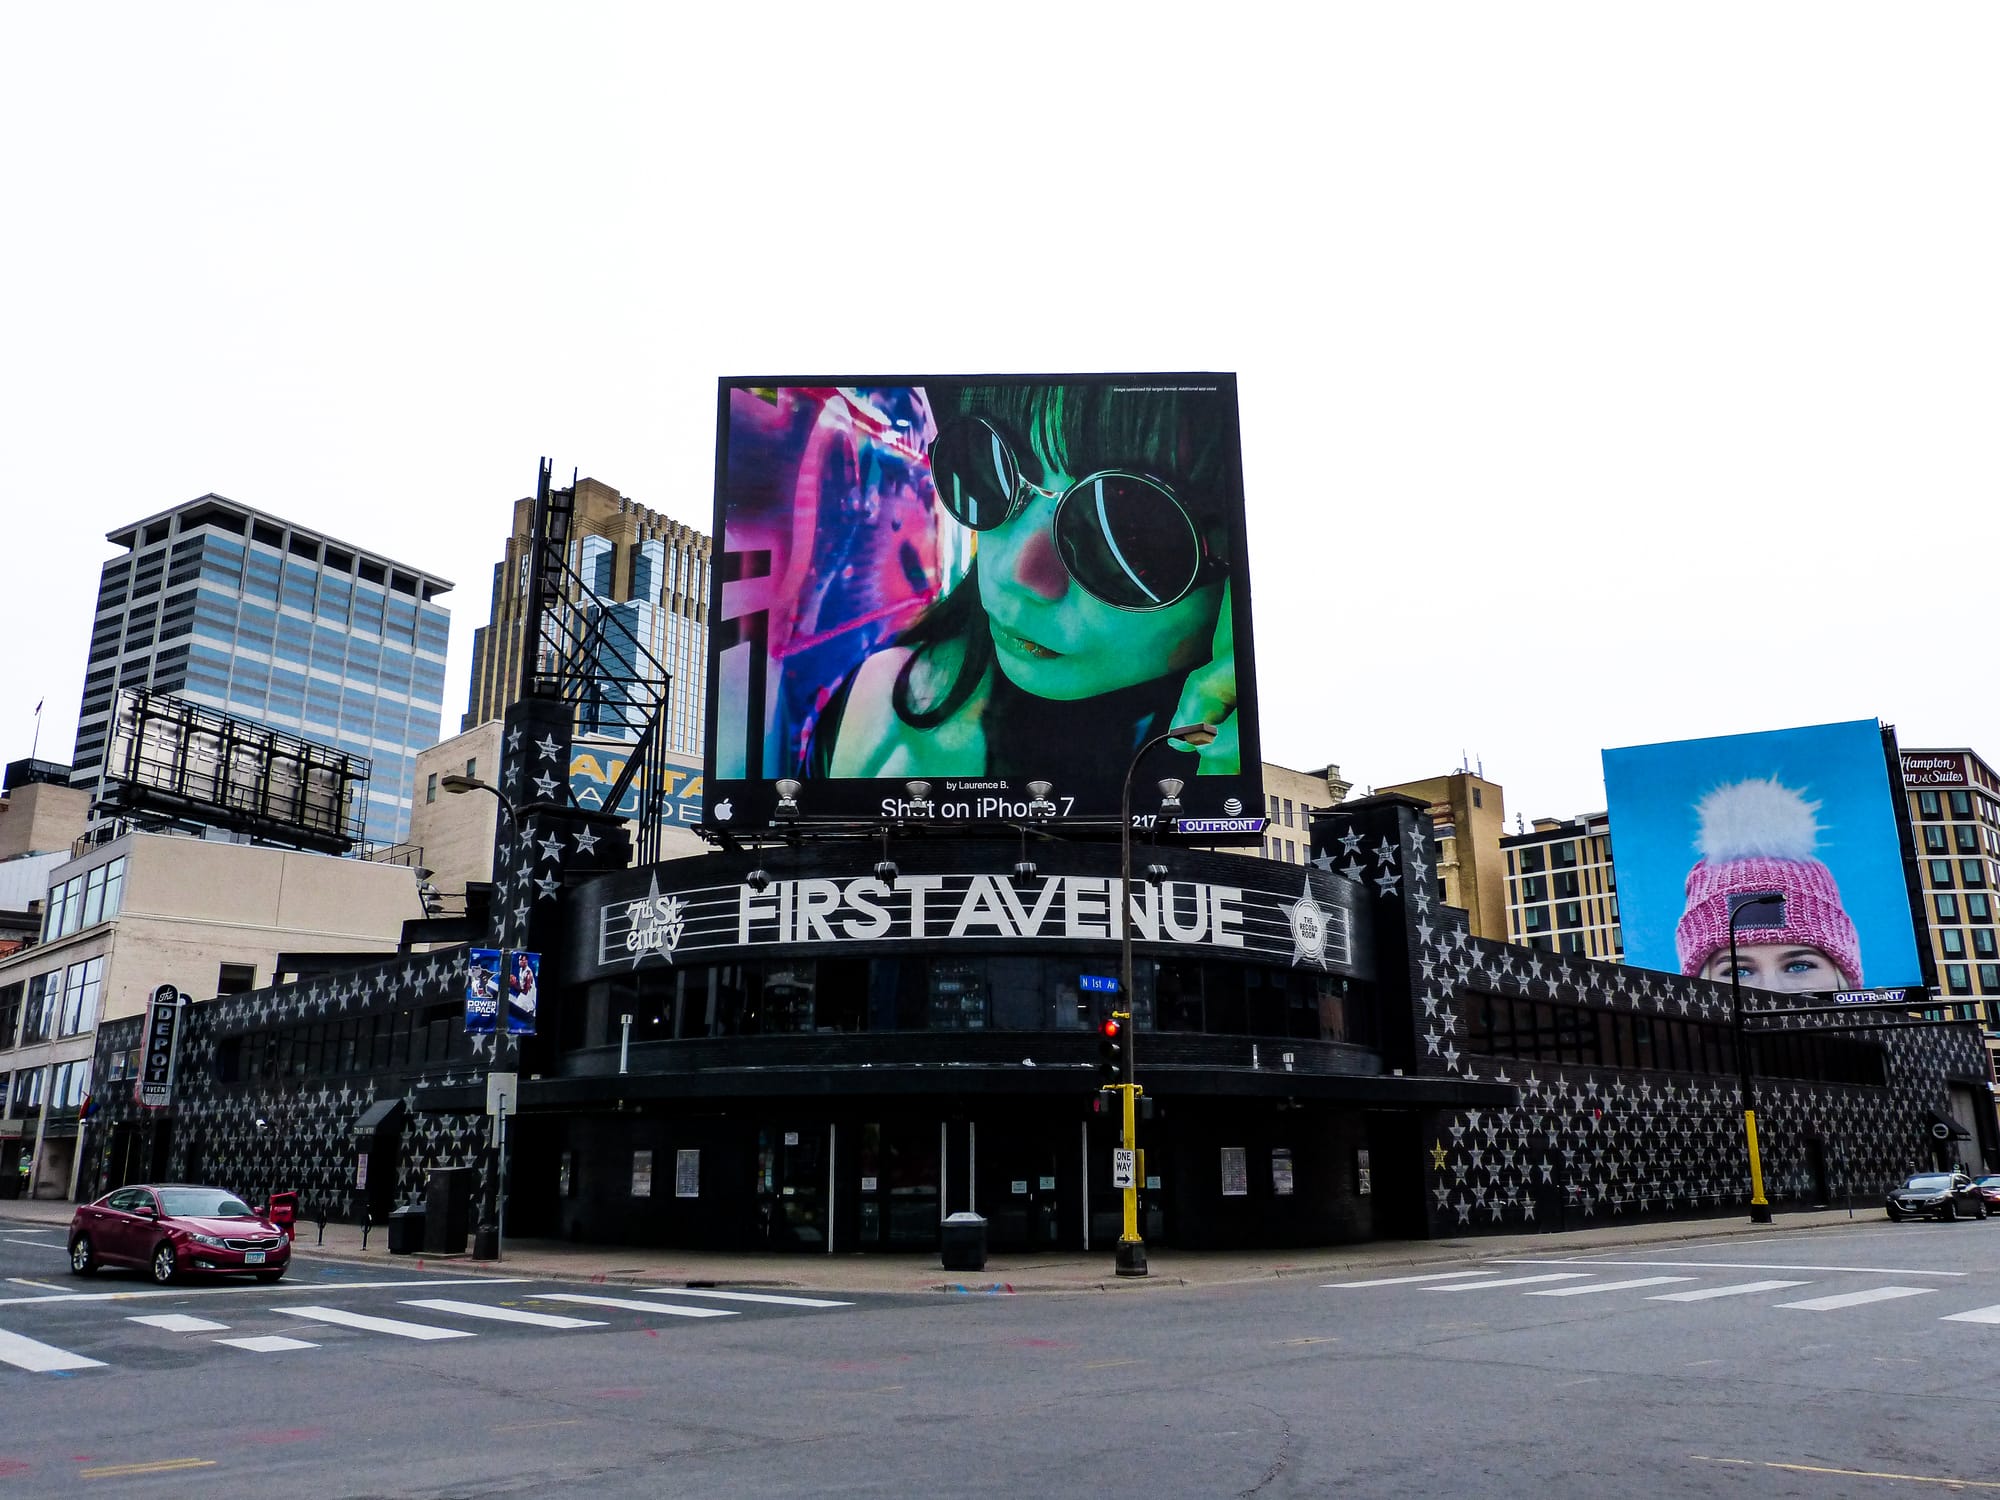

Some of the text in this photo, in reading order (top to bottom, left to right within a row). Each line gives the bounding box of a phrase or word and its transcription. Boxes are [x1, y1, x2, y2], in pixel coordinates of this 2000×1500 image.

[1901, 756, 1955, 771] Hampton
[1904, 770, 1963, 784] nn & Suites
[946, 781, 1009, 791] by Laurence B.
[941, 804, 970, 818] on
[1060, 797, 1075, 817] 7
[1132, 815, 1157, 828] 217
[1186, 820, 1255, 831] OUTFRONT
[627, 896, 683, 930] 7th St
[738, 875, 1244, 948] FIRST AVENUE
[1304, 916, 1313, 924] THE
[1300, 923, 1318, 933] RECORD
[626, 921, 685, 952] entry
[1302, 930, 1316, 938] ROOM
[1083, 978, 1088, 987] N
[1093, 979, 1102, 989] 1st
[159, 987, 174, 1002] The
[1836, 991, 1902, 1002] OUTFRNT
[467, 1000, 497, 1009] POWER
[475, 1006, 496, 1014] PACK
[151, 1007, 172, 1080] DEPOT
[1117, 1152, 1131, 1161] ONE
[1116, 1162, 1131, 1171] WAY
